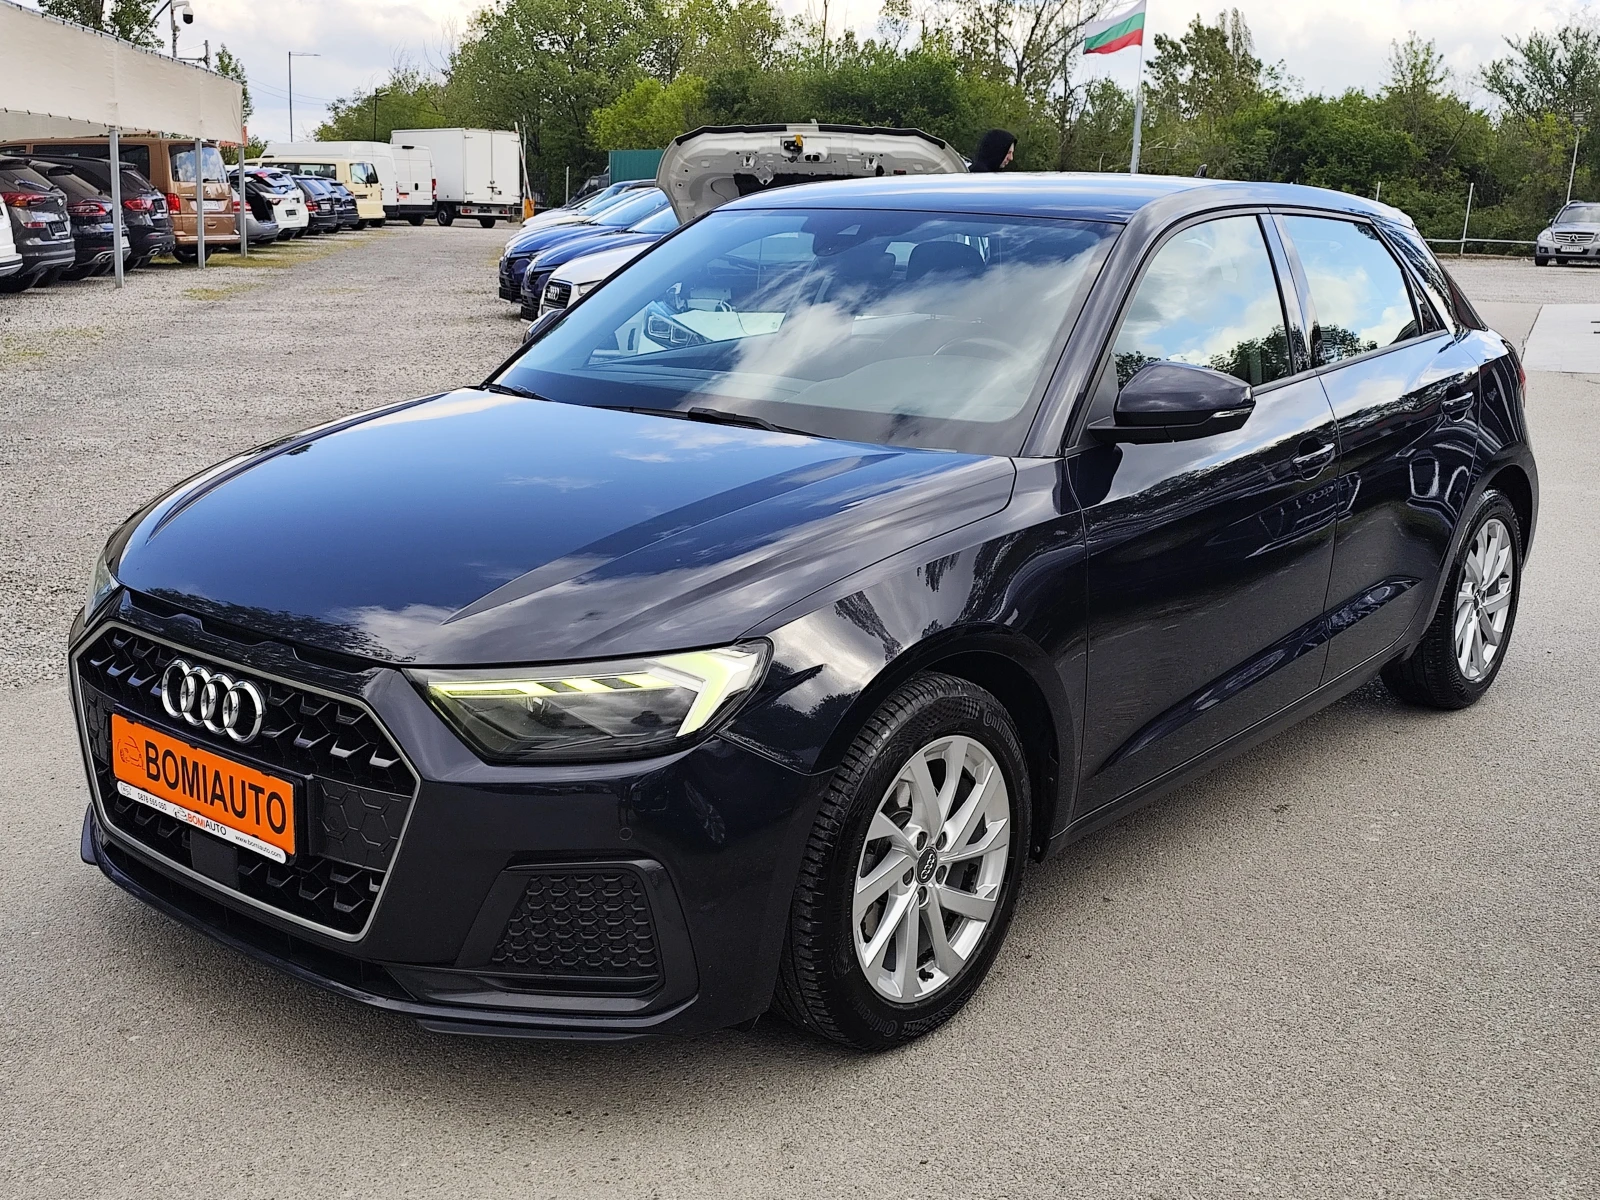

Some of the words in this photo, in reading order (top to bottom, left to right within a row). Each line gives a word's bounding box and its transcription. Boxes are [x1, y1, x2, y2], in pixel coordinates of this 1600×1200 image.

[144, 739, 287, 835] BOMIAUTO
[187, 813, 227, 836] BOMIAUTO
[234, 835, 282, 859] www.bomiauto.com
